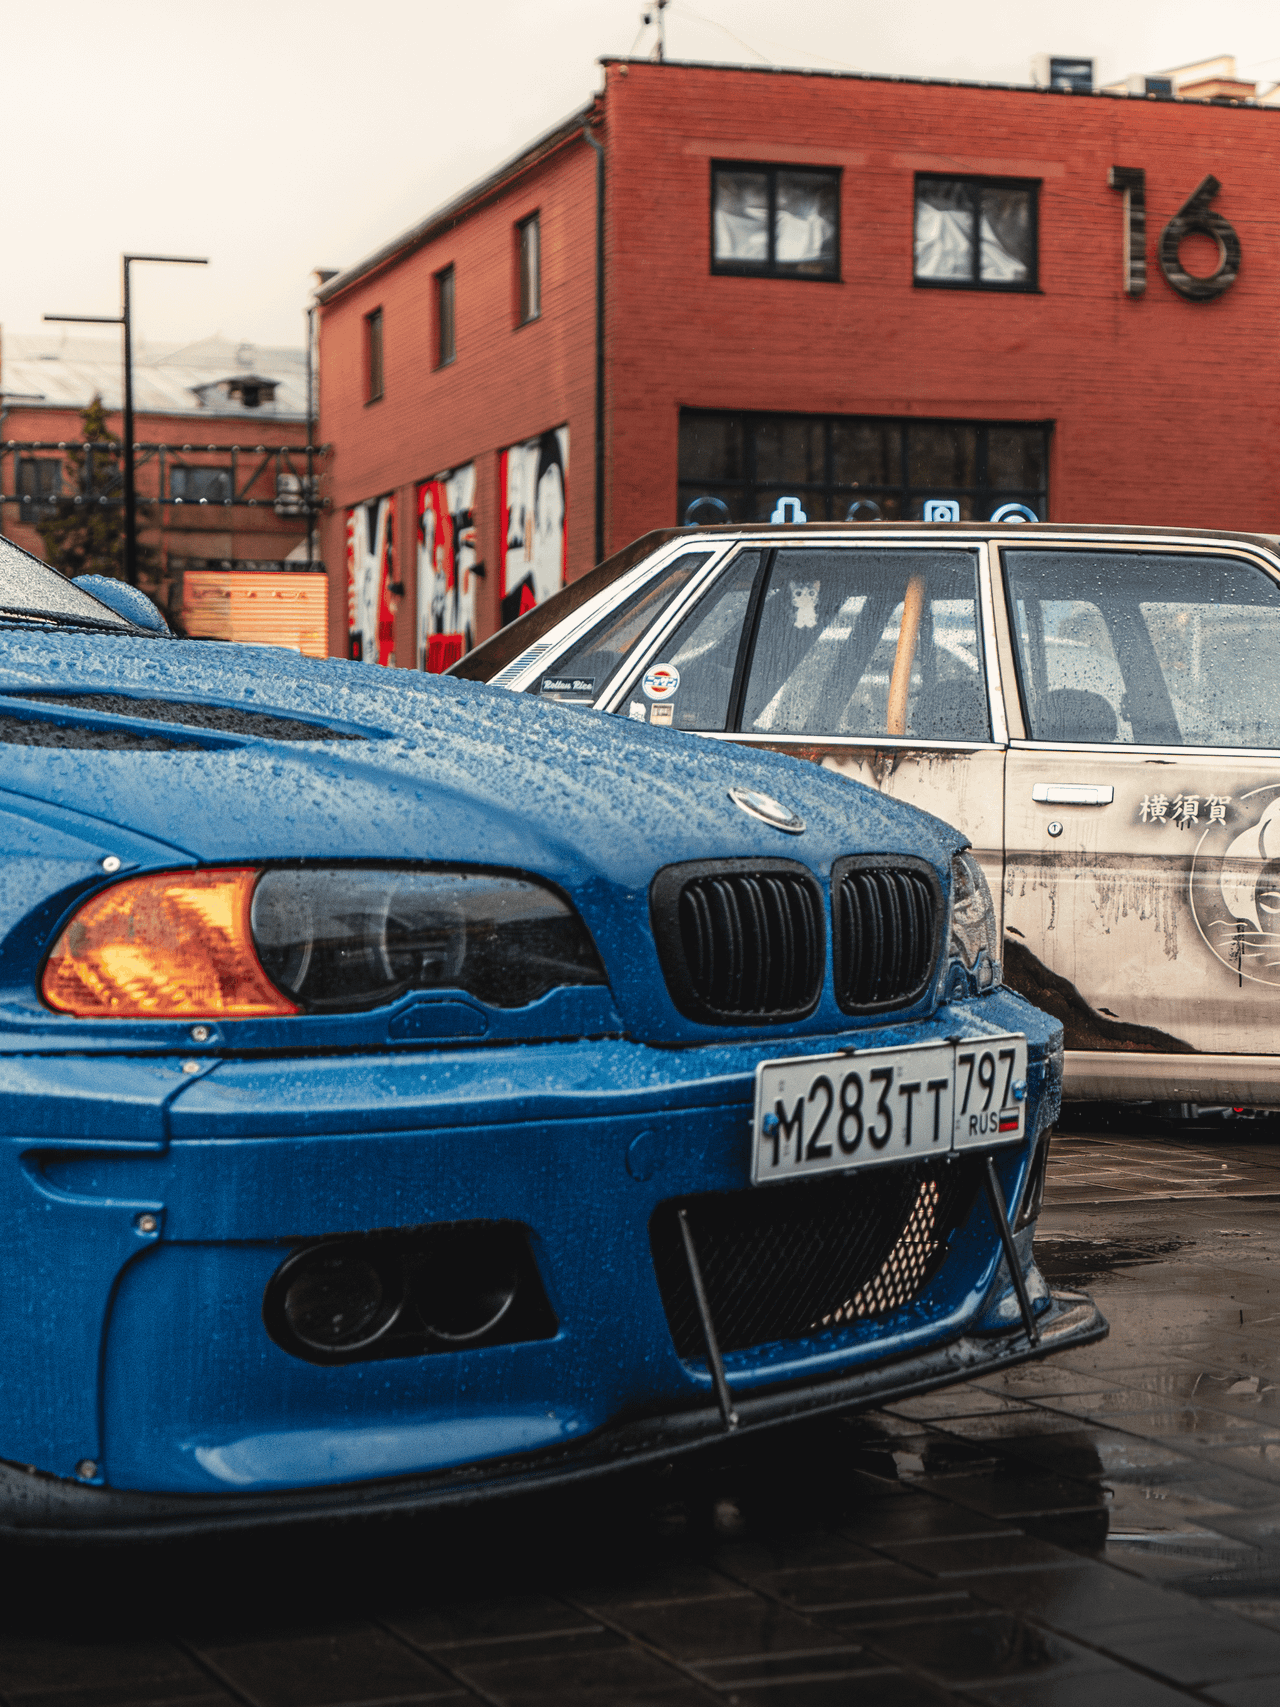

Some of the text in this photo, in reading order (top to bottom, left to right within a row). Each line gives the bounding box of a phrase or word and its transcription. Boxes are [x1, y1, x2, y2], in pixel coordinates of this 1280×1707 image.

[1107, 165, 1241, 303] 16
[573, 680, 593, 690] Rice
[1139, 793, 1232, 826] 横須賀
[772, 1048, 1016, 1167] М283ТТ 797
[969, 1111, 998, 1136] RUS
